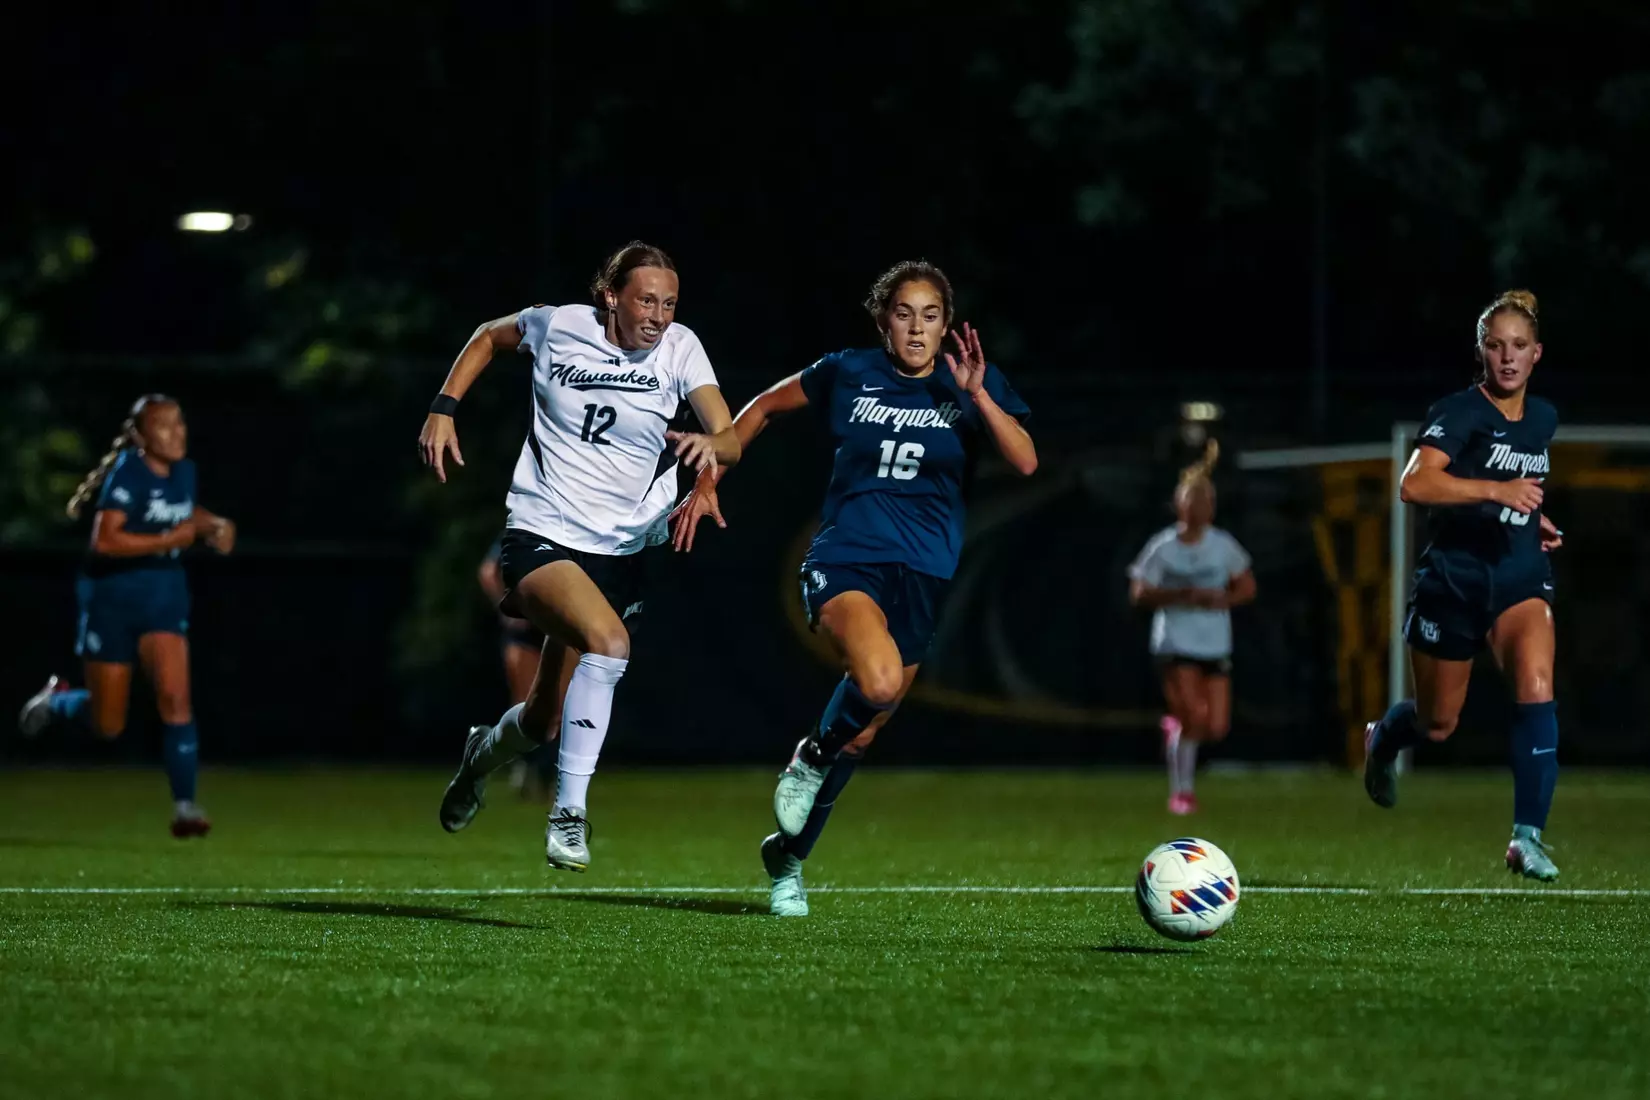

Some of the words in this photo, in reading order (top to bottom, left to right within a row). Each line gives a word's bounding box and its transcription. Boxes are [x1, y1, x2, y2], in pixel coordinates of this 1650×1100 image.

[549, 363, 660, 392] Milwaukee
[581, 404, 617, 445] 12
[849, 396, 962, 433] Marquette
[877, 440, 926, 481] 16
